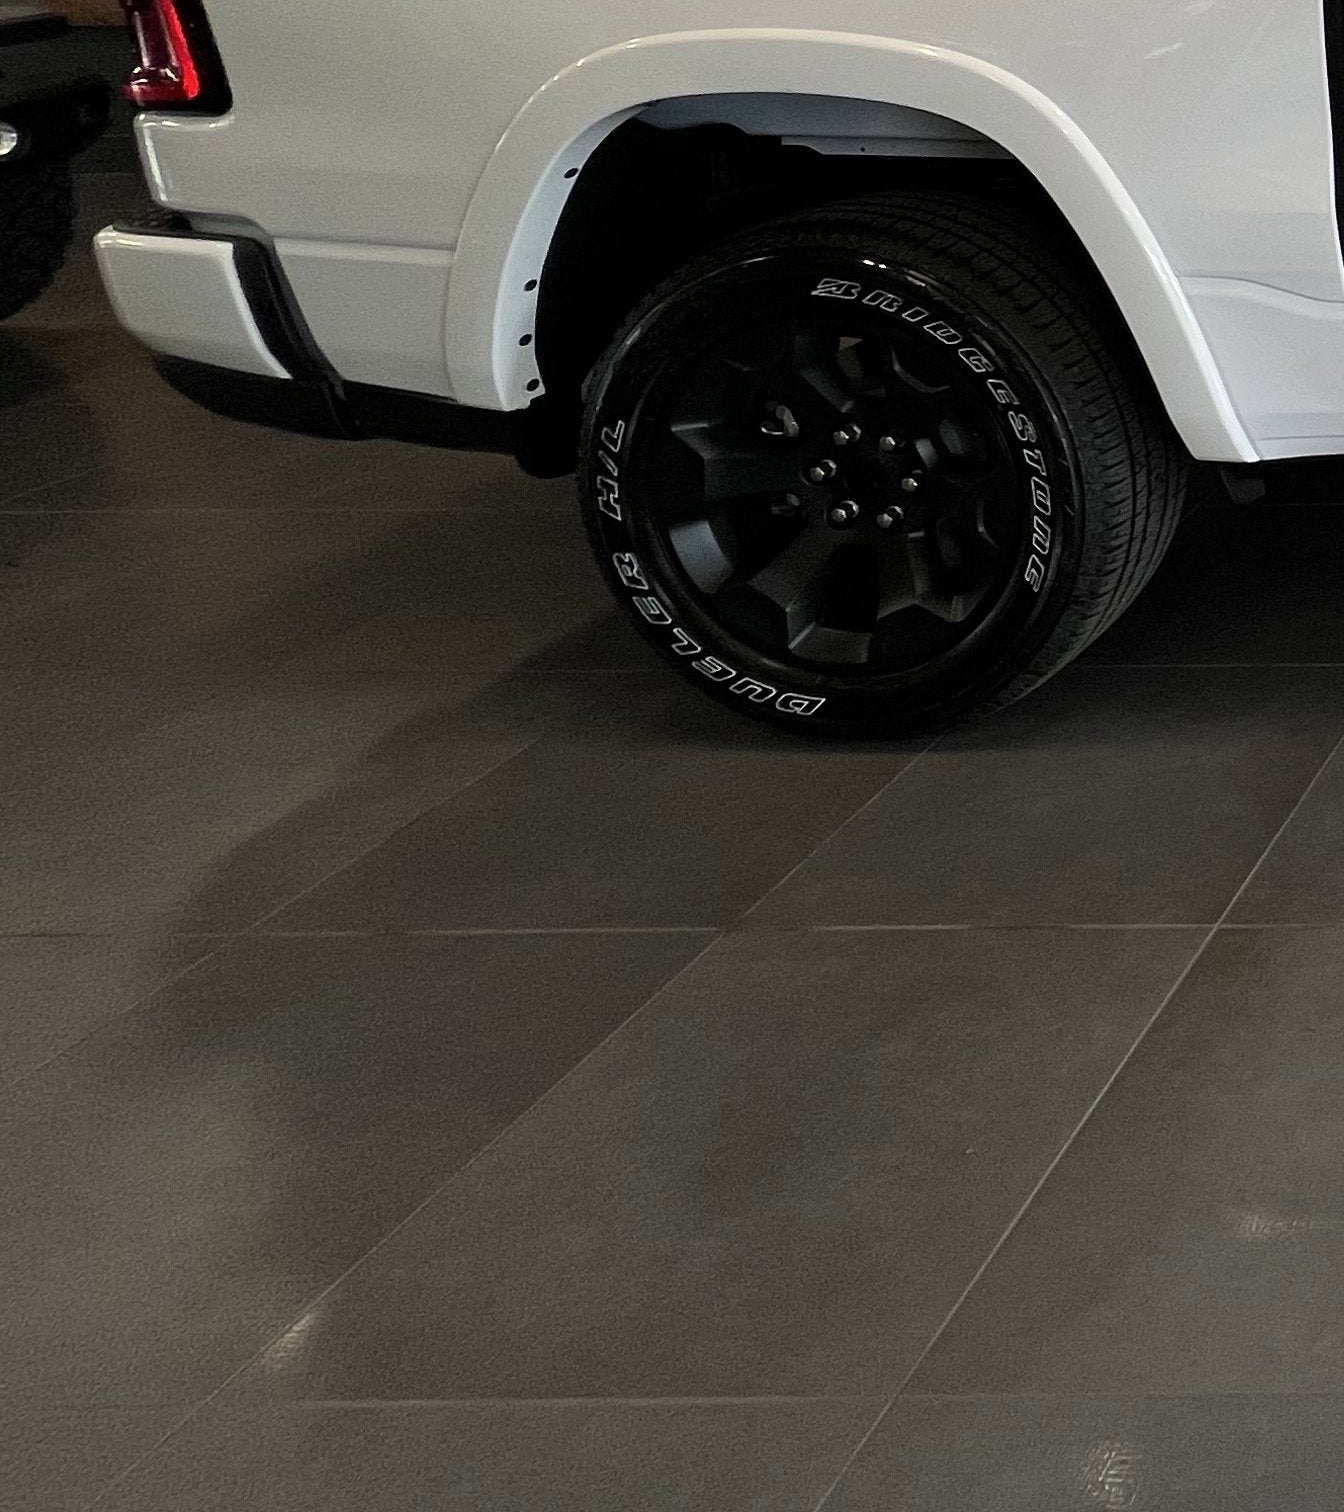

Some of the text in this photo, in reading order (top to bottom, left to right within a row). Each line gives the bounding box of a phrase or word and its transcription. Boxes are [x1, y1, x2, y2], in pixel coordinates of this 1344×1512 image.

[596, 419, 827, 716] DUELER H/L
[810, 277, 1052, 593] BRIDGESTONE
